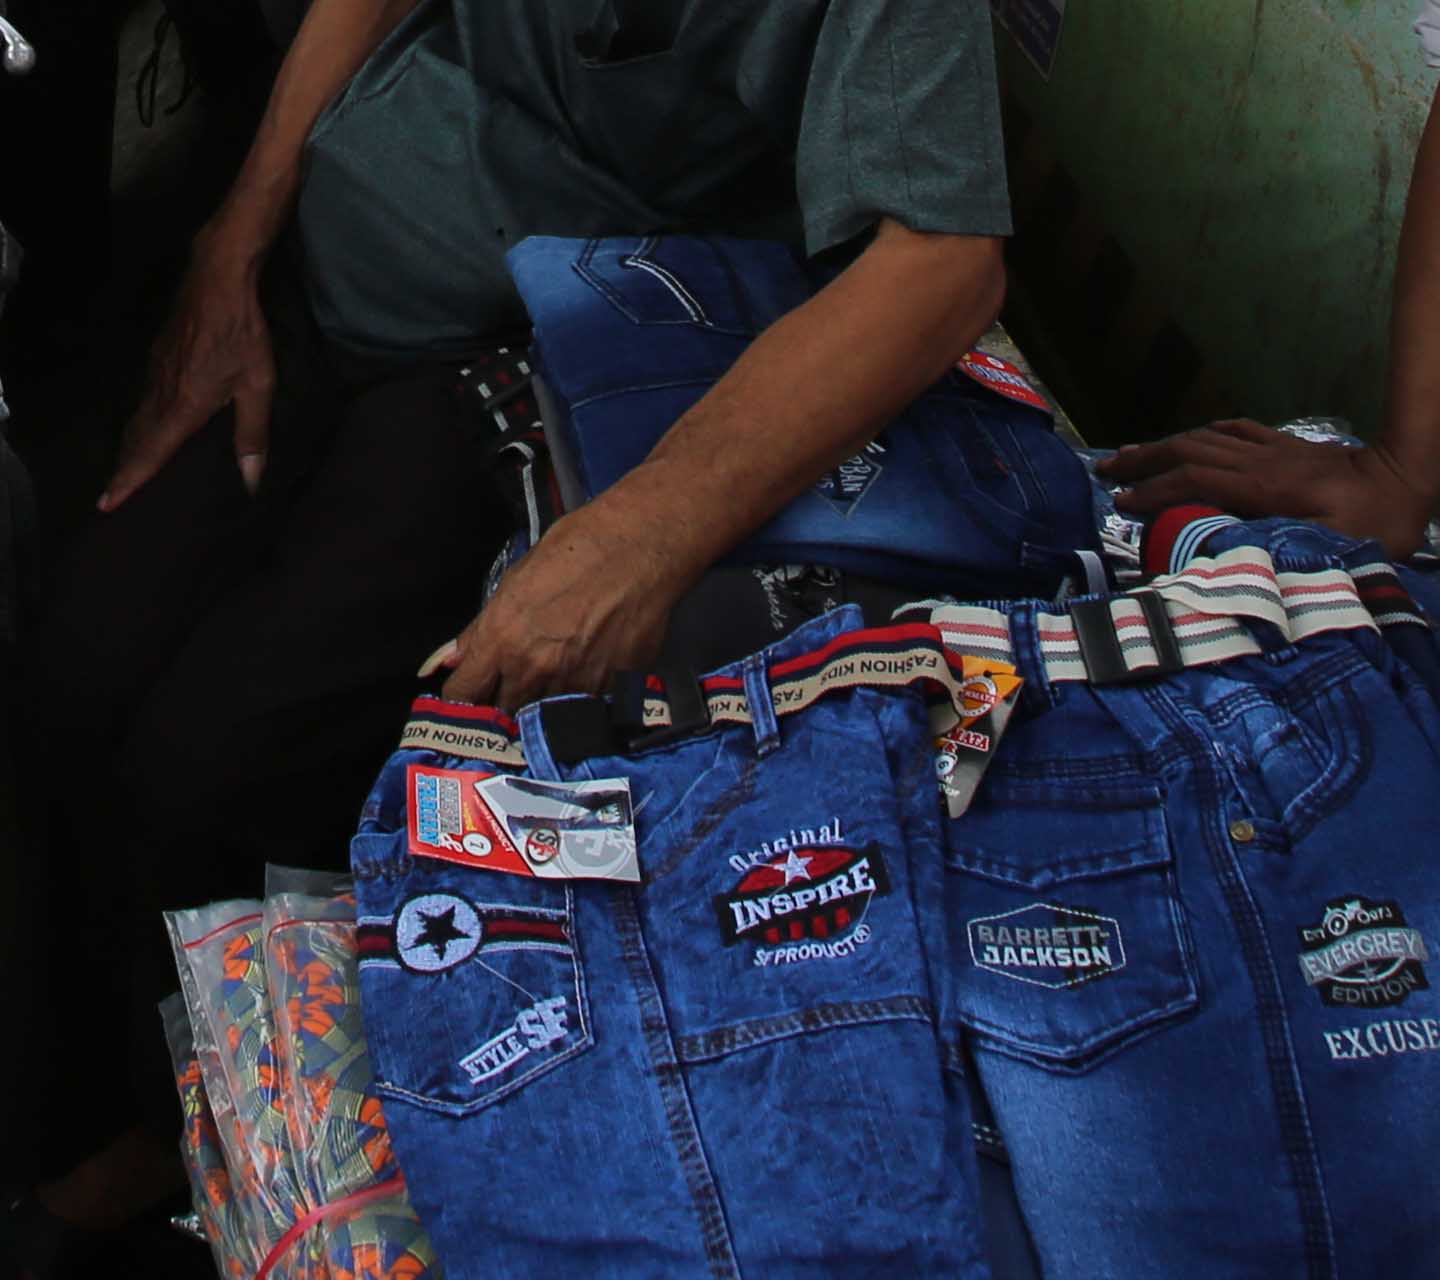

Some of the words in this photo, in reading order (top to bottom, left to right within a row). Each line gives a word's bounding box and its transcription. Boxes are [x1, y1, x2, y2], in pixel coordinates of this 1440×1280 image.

[859, 654, 938, 674] FASHION
[431, 729, 509, 753] FASHION
[728, 857, 878, 935] INSPIRE
[983, 944, 1113, 967] JACKSON
[1332, 969, 1417, 1004] EDITION
[464, 1035, 523, 1078] STYLE
